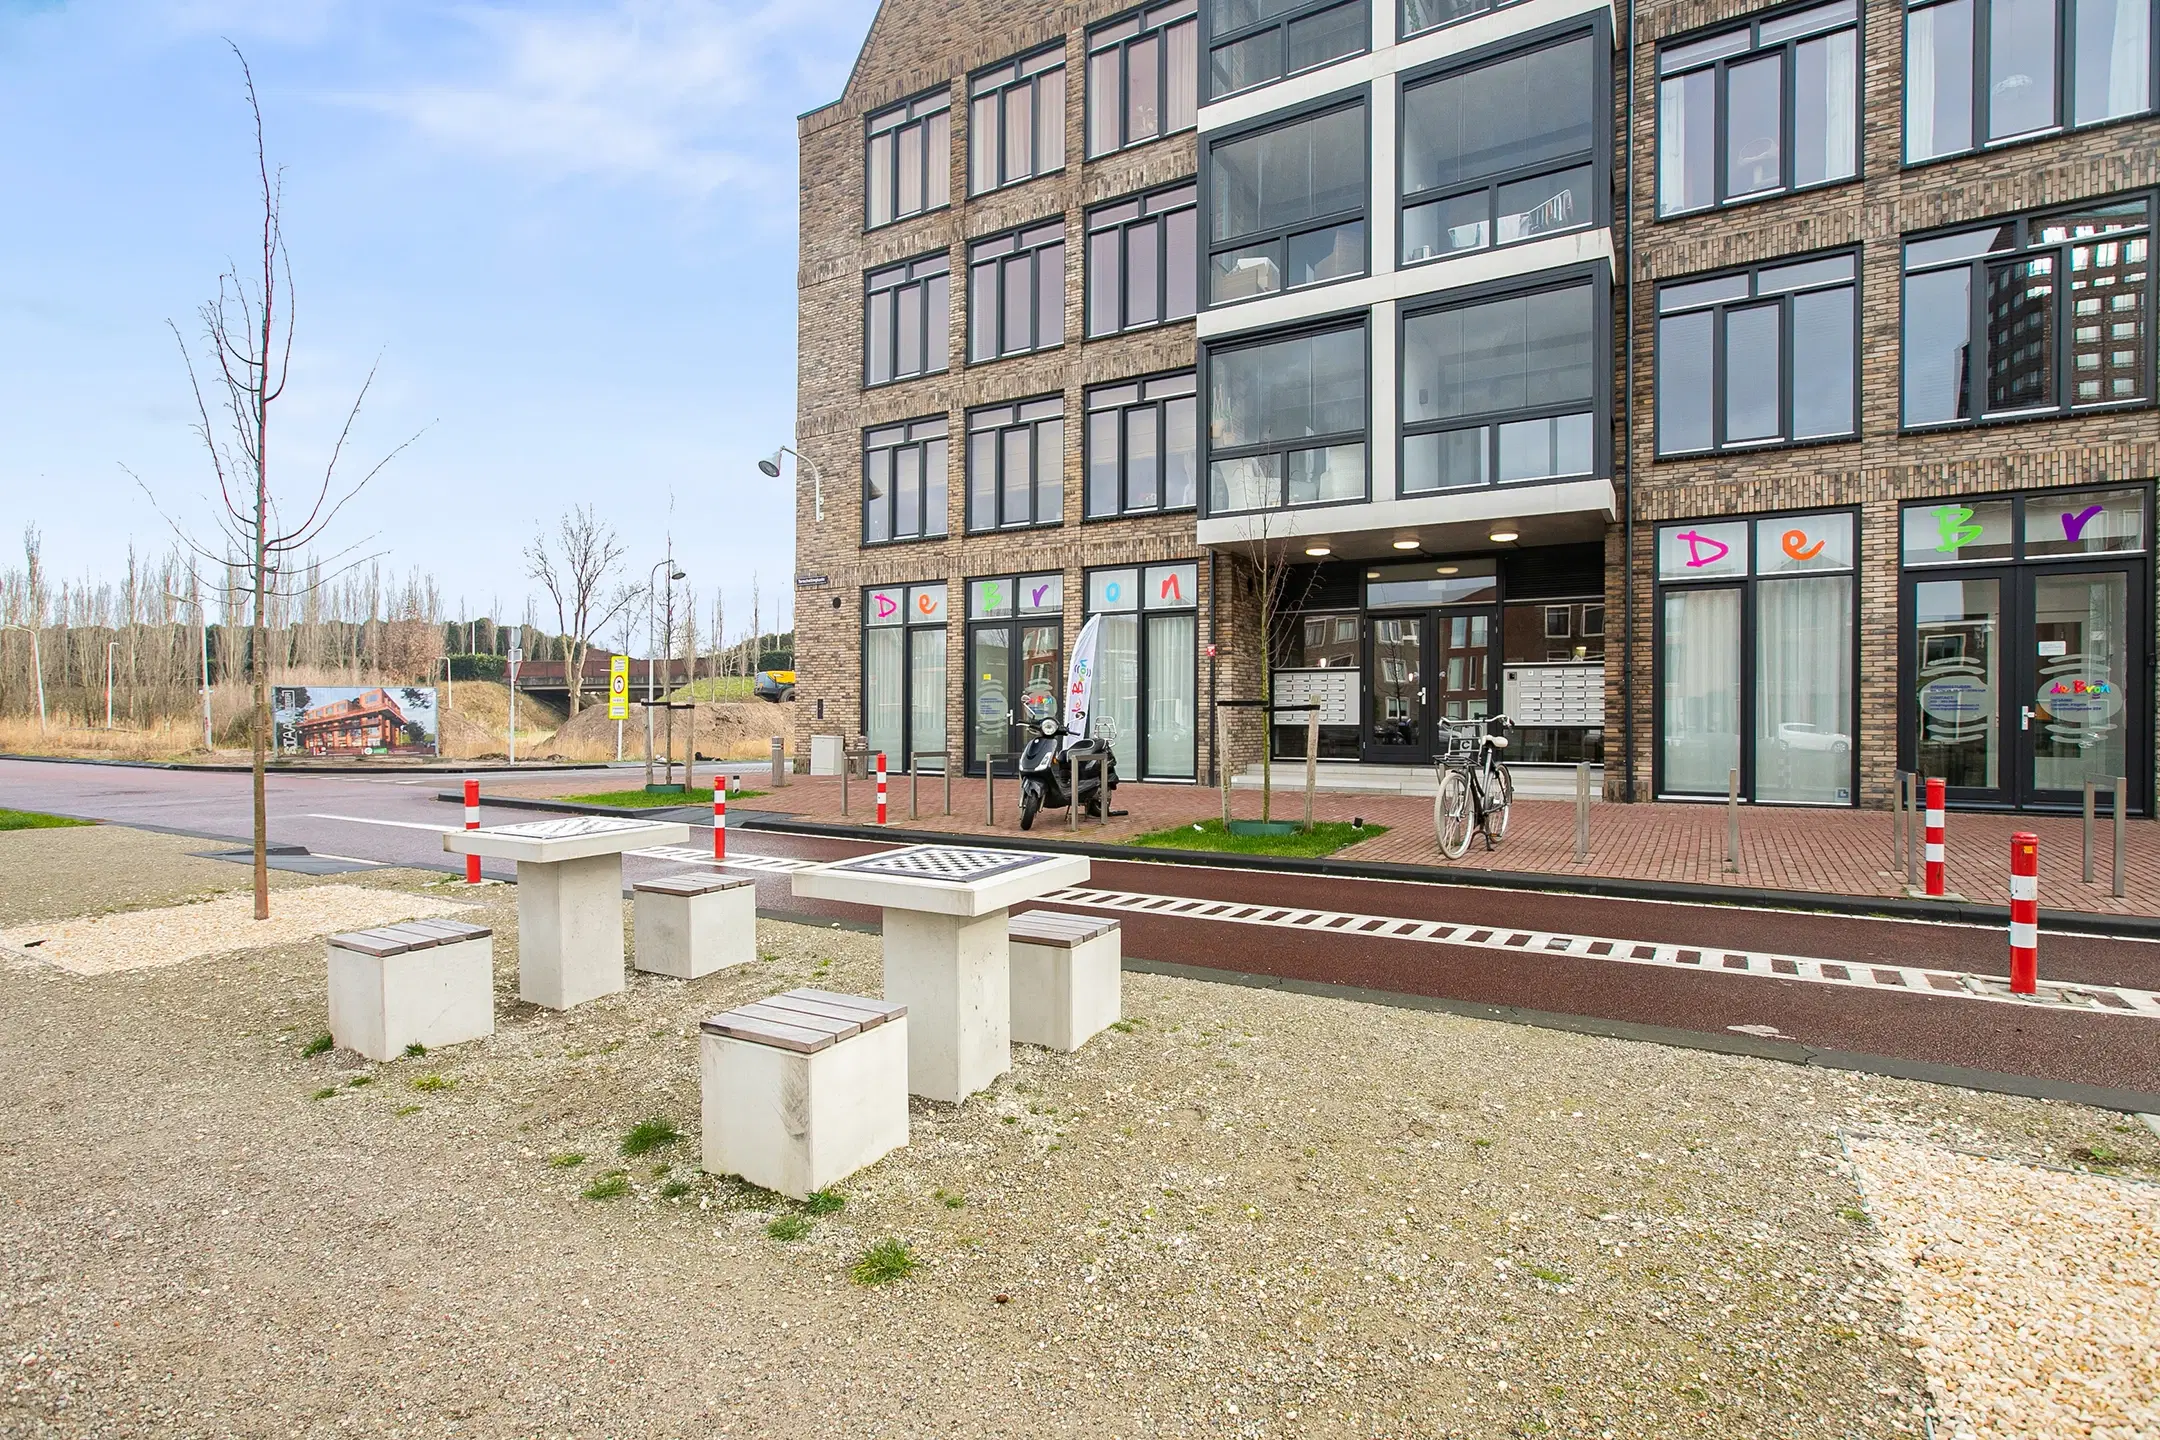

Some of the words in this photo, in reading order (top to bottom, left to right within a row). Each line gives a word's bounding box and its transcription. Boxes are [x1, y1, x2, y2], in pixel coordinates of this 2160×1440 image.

[980, 574, 1181, 612] Bron
[2050, 682, 2071, 694] de
[2073, 680, 2111, 694] Bron
